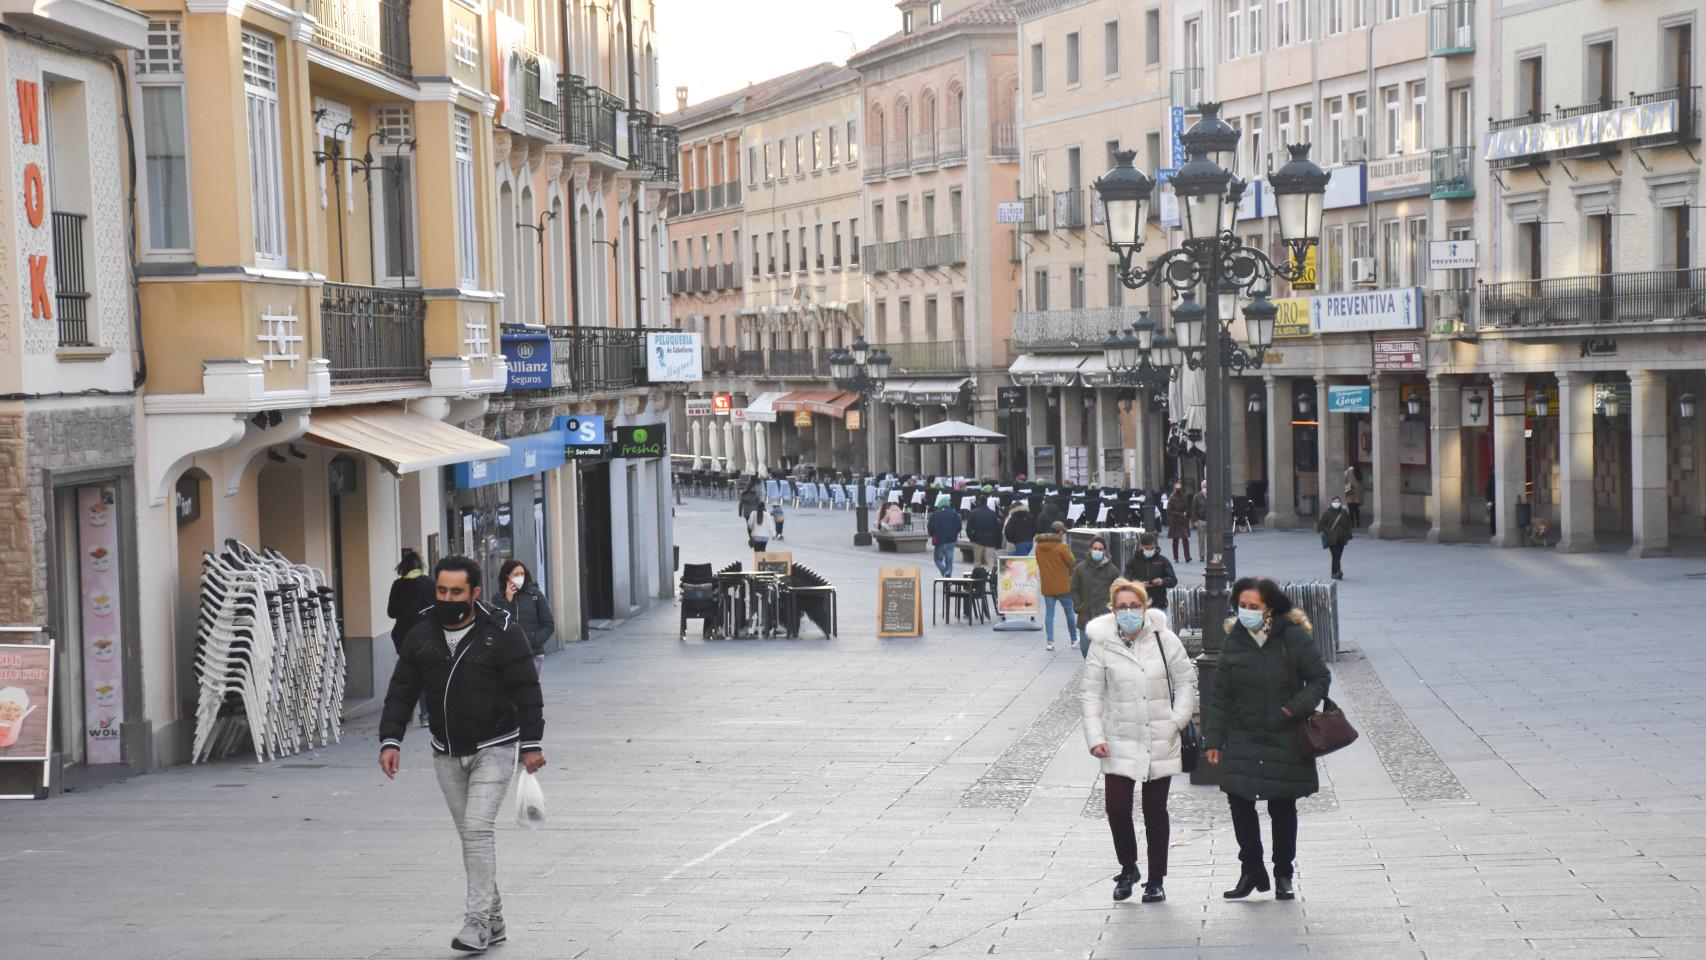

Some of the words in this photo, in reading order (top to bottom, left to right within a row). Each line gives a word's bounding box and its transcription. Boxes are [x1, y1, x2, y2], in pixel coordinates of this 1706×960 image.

[1173, 109, 1183, 168] OFICINAS
[1369, 163, 1393, 178] TALLER
[1394, 162, 1404, 175] DE
[16, 79, 52, 320] WOK
[1275, 302, 1298, 324] ORO
[1327, 293, 1395, 316] PREVENTIVA
[655, 334, 693, 345] PELUQUERIA
[507, 361, 548, 373] Allianz
[511, 375, 542, 386] Seguros
[579, 421, 596, 442] S
